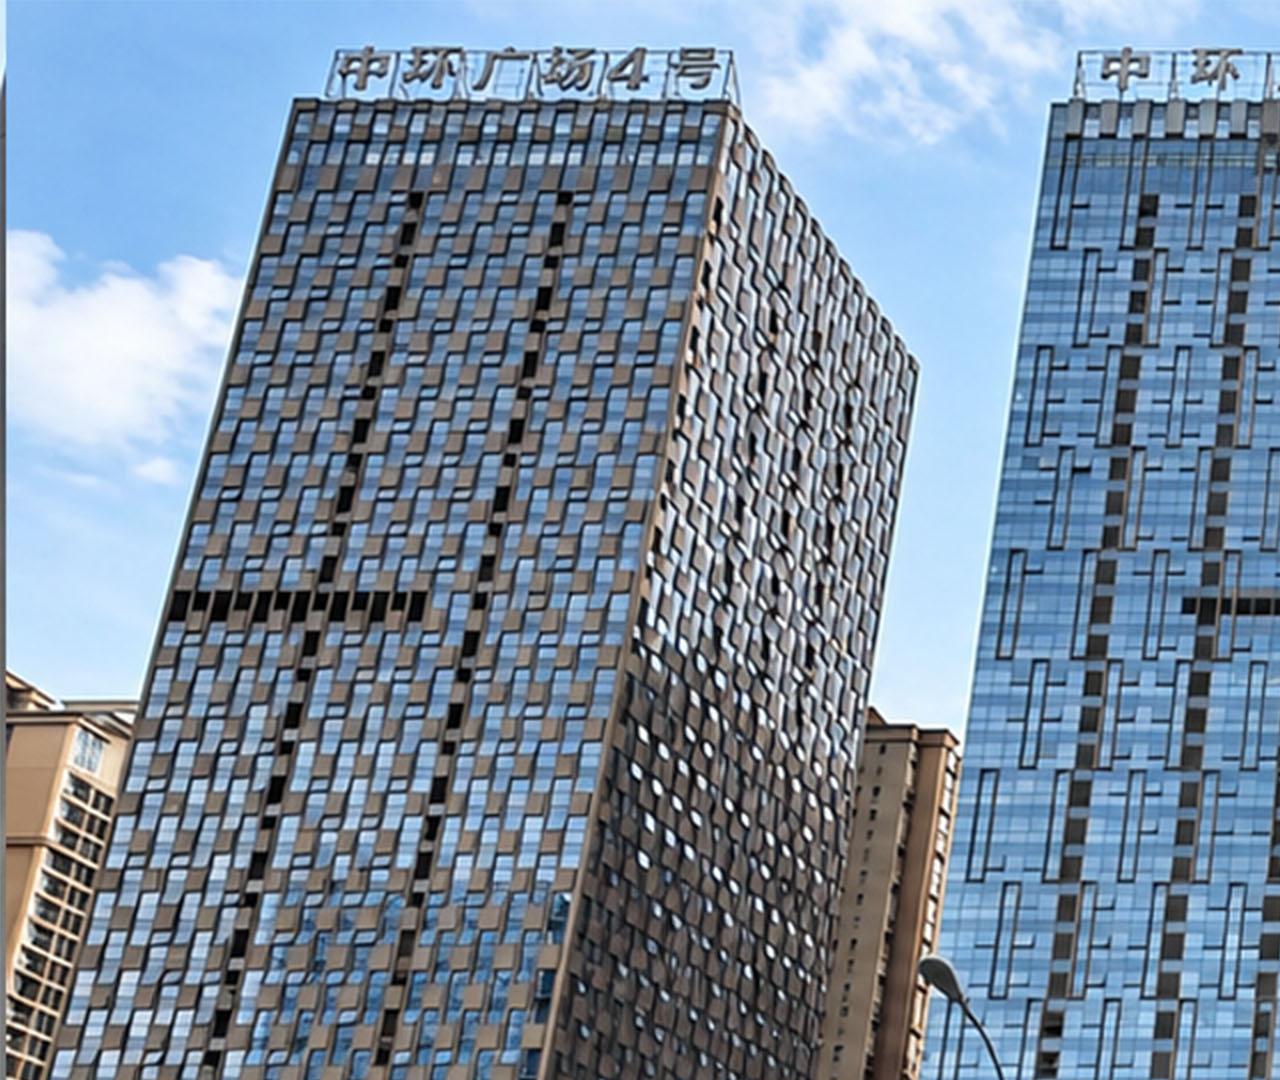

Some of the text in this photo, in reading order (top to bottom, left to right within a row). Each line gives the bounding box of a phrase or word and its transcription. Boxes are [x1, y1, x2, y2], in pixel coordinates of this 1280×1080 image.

[338, 46, 720, 90] 中环广场4号
